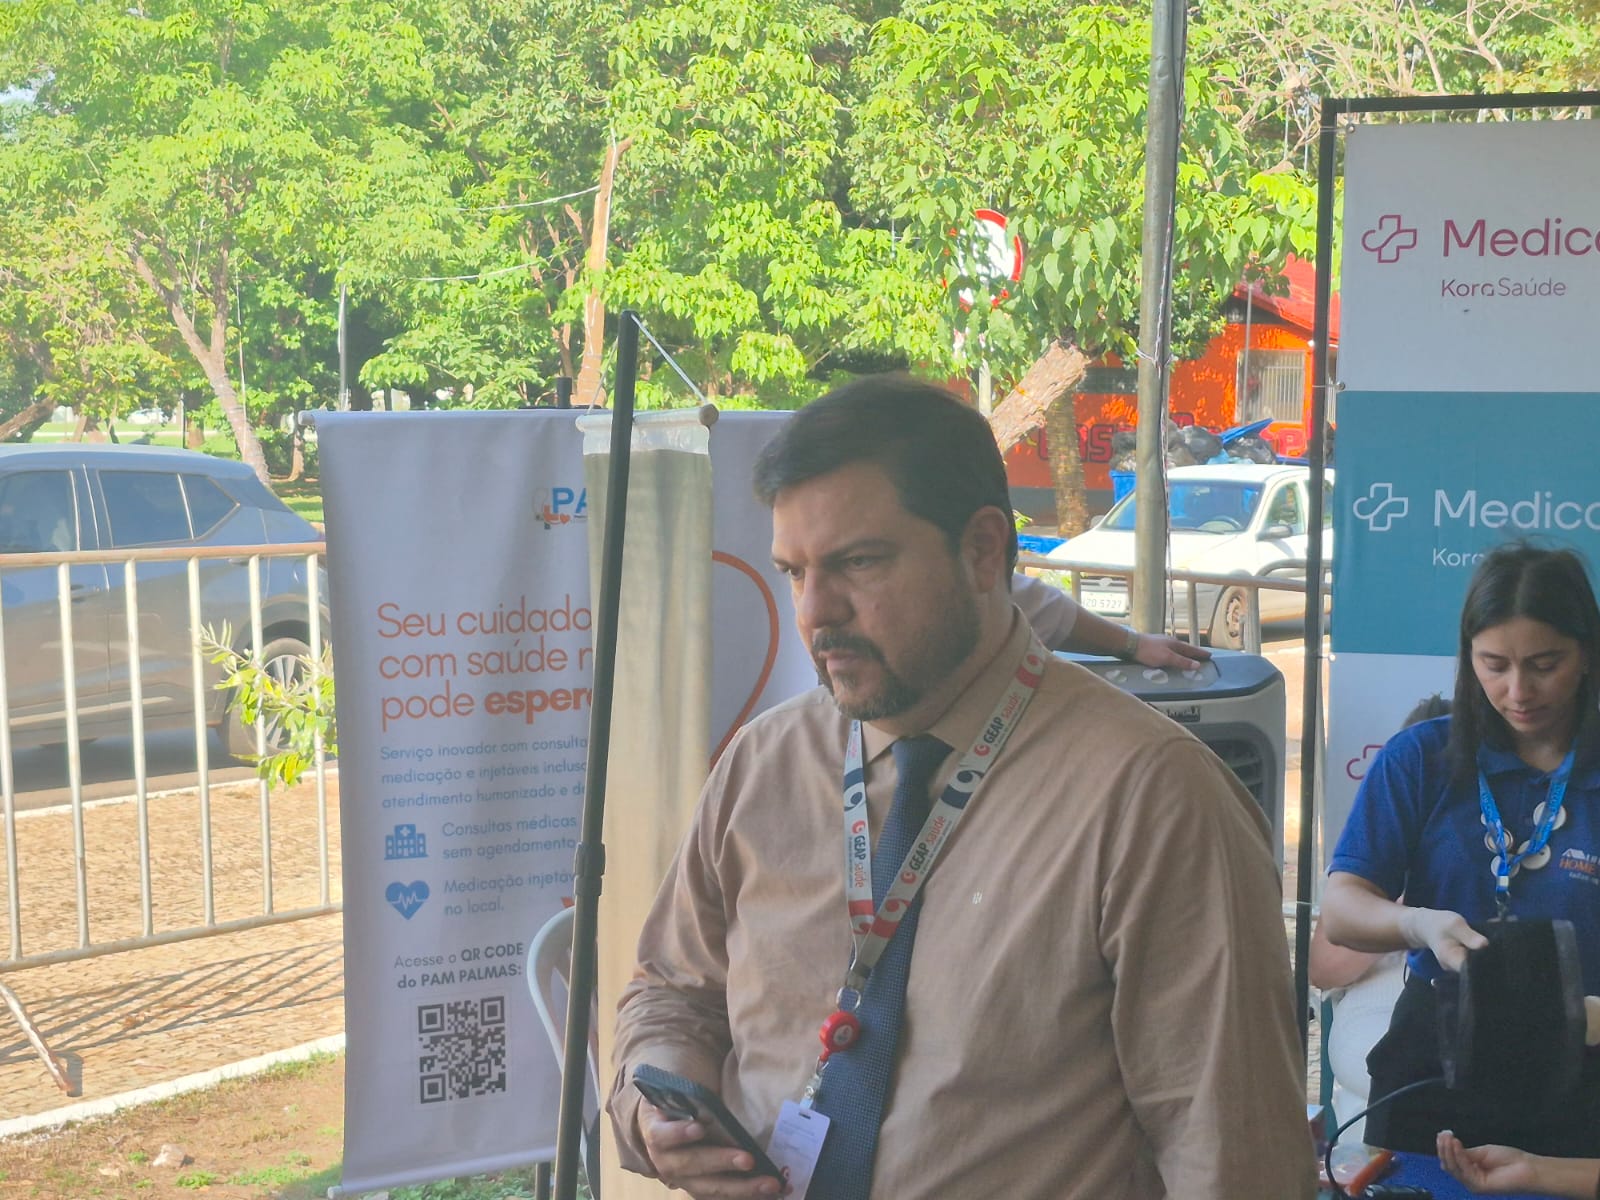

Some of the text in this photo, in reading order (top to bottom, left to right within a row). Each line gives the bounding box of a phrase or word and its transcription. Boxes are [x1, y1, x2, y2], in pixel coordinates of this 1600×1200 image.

[1443, 217, 1600, 257] Medic
[377, 593, 592, 639] Seu cuidado
[379, 653, 457, 679] com
[467, 635, 569, 676] saúde
[382, 680, 592, 733] pode esper
[983, 716, 1005, 744] GEAP
[380, 746, 433, 762] Serviço
[438, 739, 497, 757] inovador
[500, 741, 528, 753] com
[382, 768, 461, 785] medicação
[466, 769, 475, 778] e
[382, 781, 585, 809] atendimento humanizado e d
[442, 814, 577, 837] Consultas médicas
[442, 847, 473, 859] sem
[854, 835, 867, 860] GEAP
[909, 842, 930, 871] GEAP
[443, 874, 524, 893] Medicação
[444, 896, 504, 916] no local.
[394, 942, 524, 969] Acesse o QR CODE
[397, 963, 522, 989] do PAM PALMAS:
